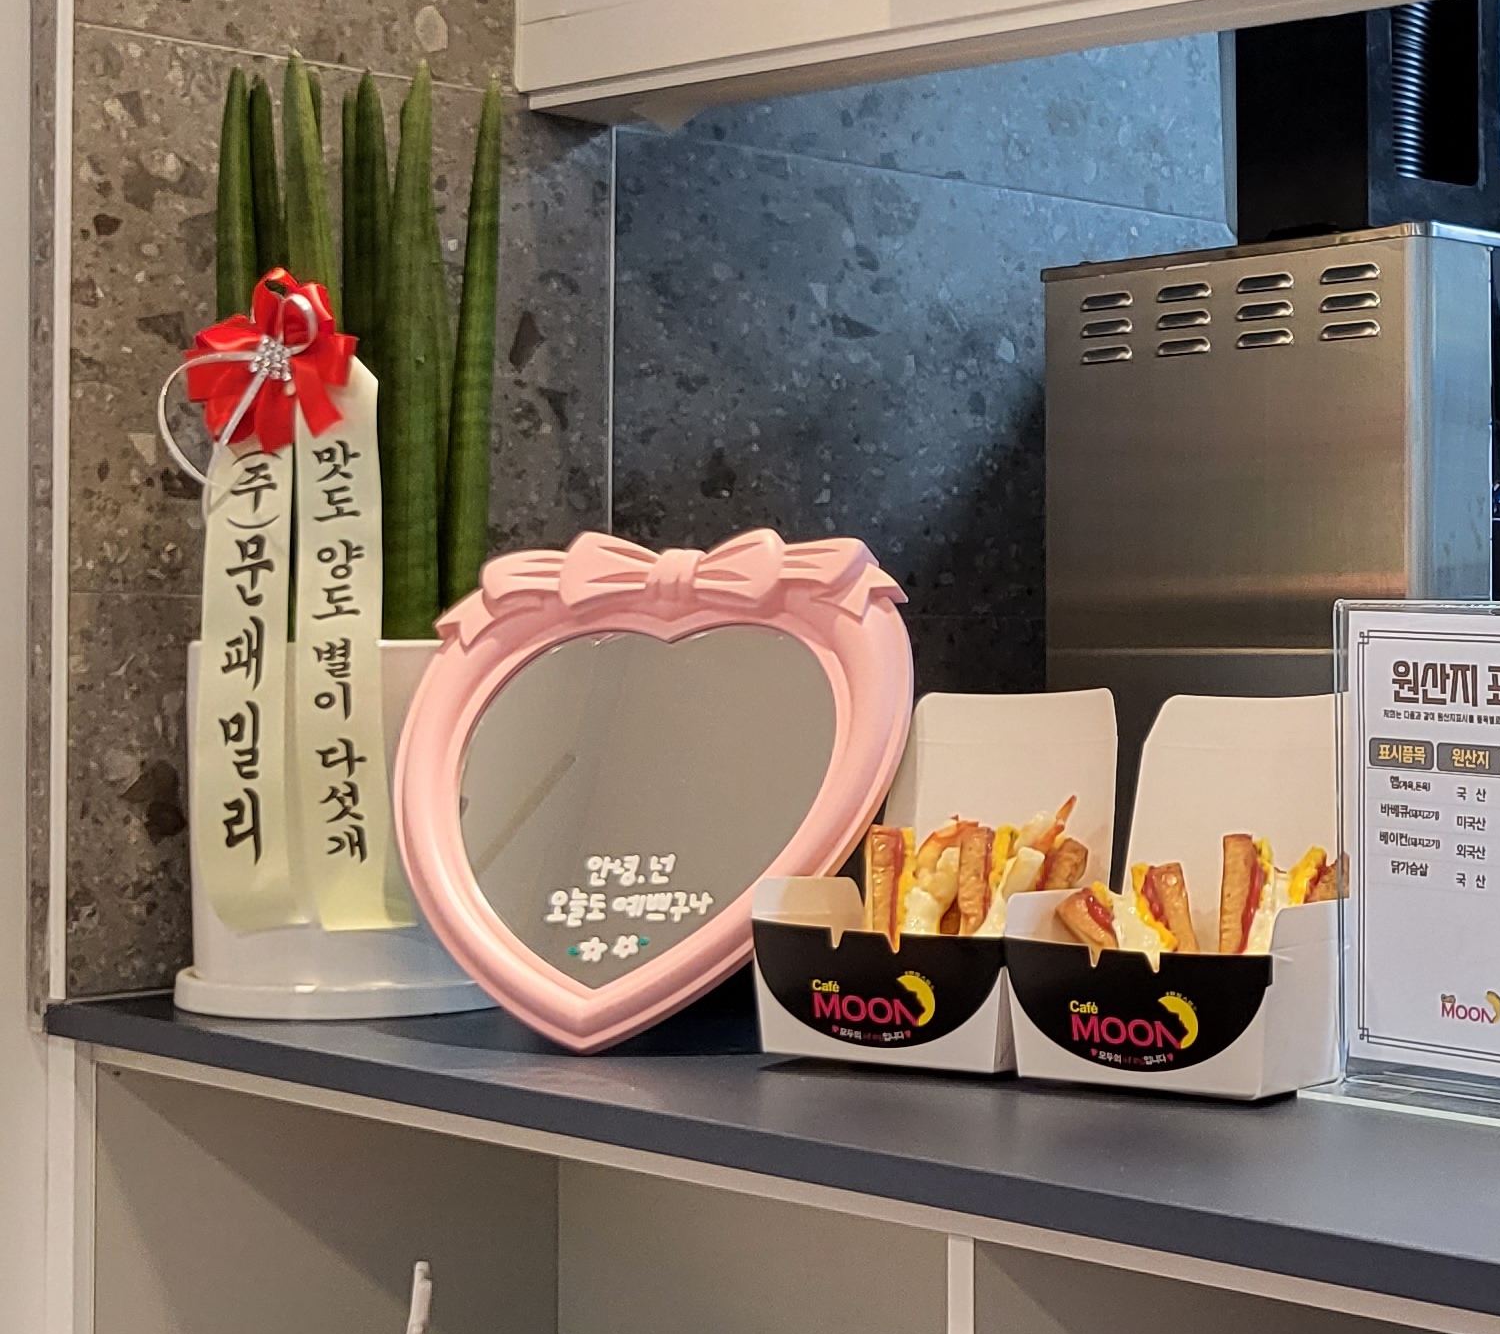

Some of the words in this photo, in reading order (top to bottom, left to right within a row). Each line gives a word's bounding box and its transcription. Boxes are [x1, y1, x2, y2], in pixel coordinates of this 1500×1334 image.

[312, 439, 363, 524] 맛도
[313, 540, 366, 621] 양도
[312, 638, 354, 722] 별이
[1391, 659, 1479, 707] 원산지
[1378, 744, 1426, 765] 표시품목
[1452, 748, 1489, 769] 원산지
[315, 738, 369, 864] 다섯개
[1456, 816, 1486, 831] 미국산
[1456, 844, 1486, 861] 외국산
[813, 992, 920, 1027] MOON
[1441, 1002, 1495, 1024] MOON
[1071, 1014, 1182, 1050] MOON
